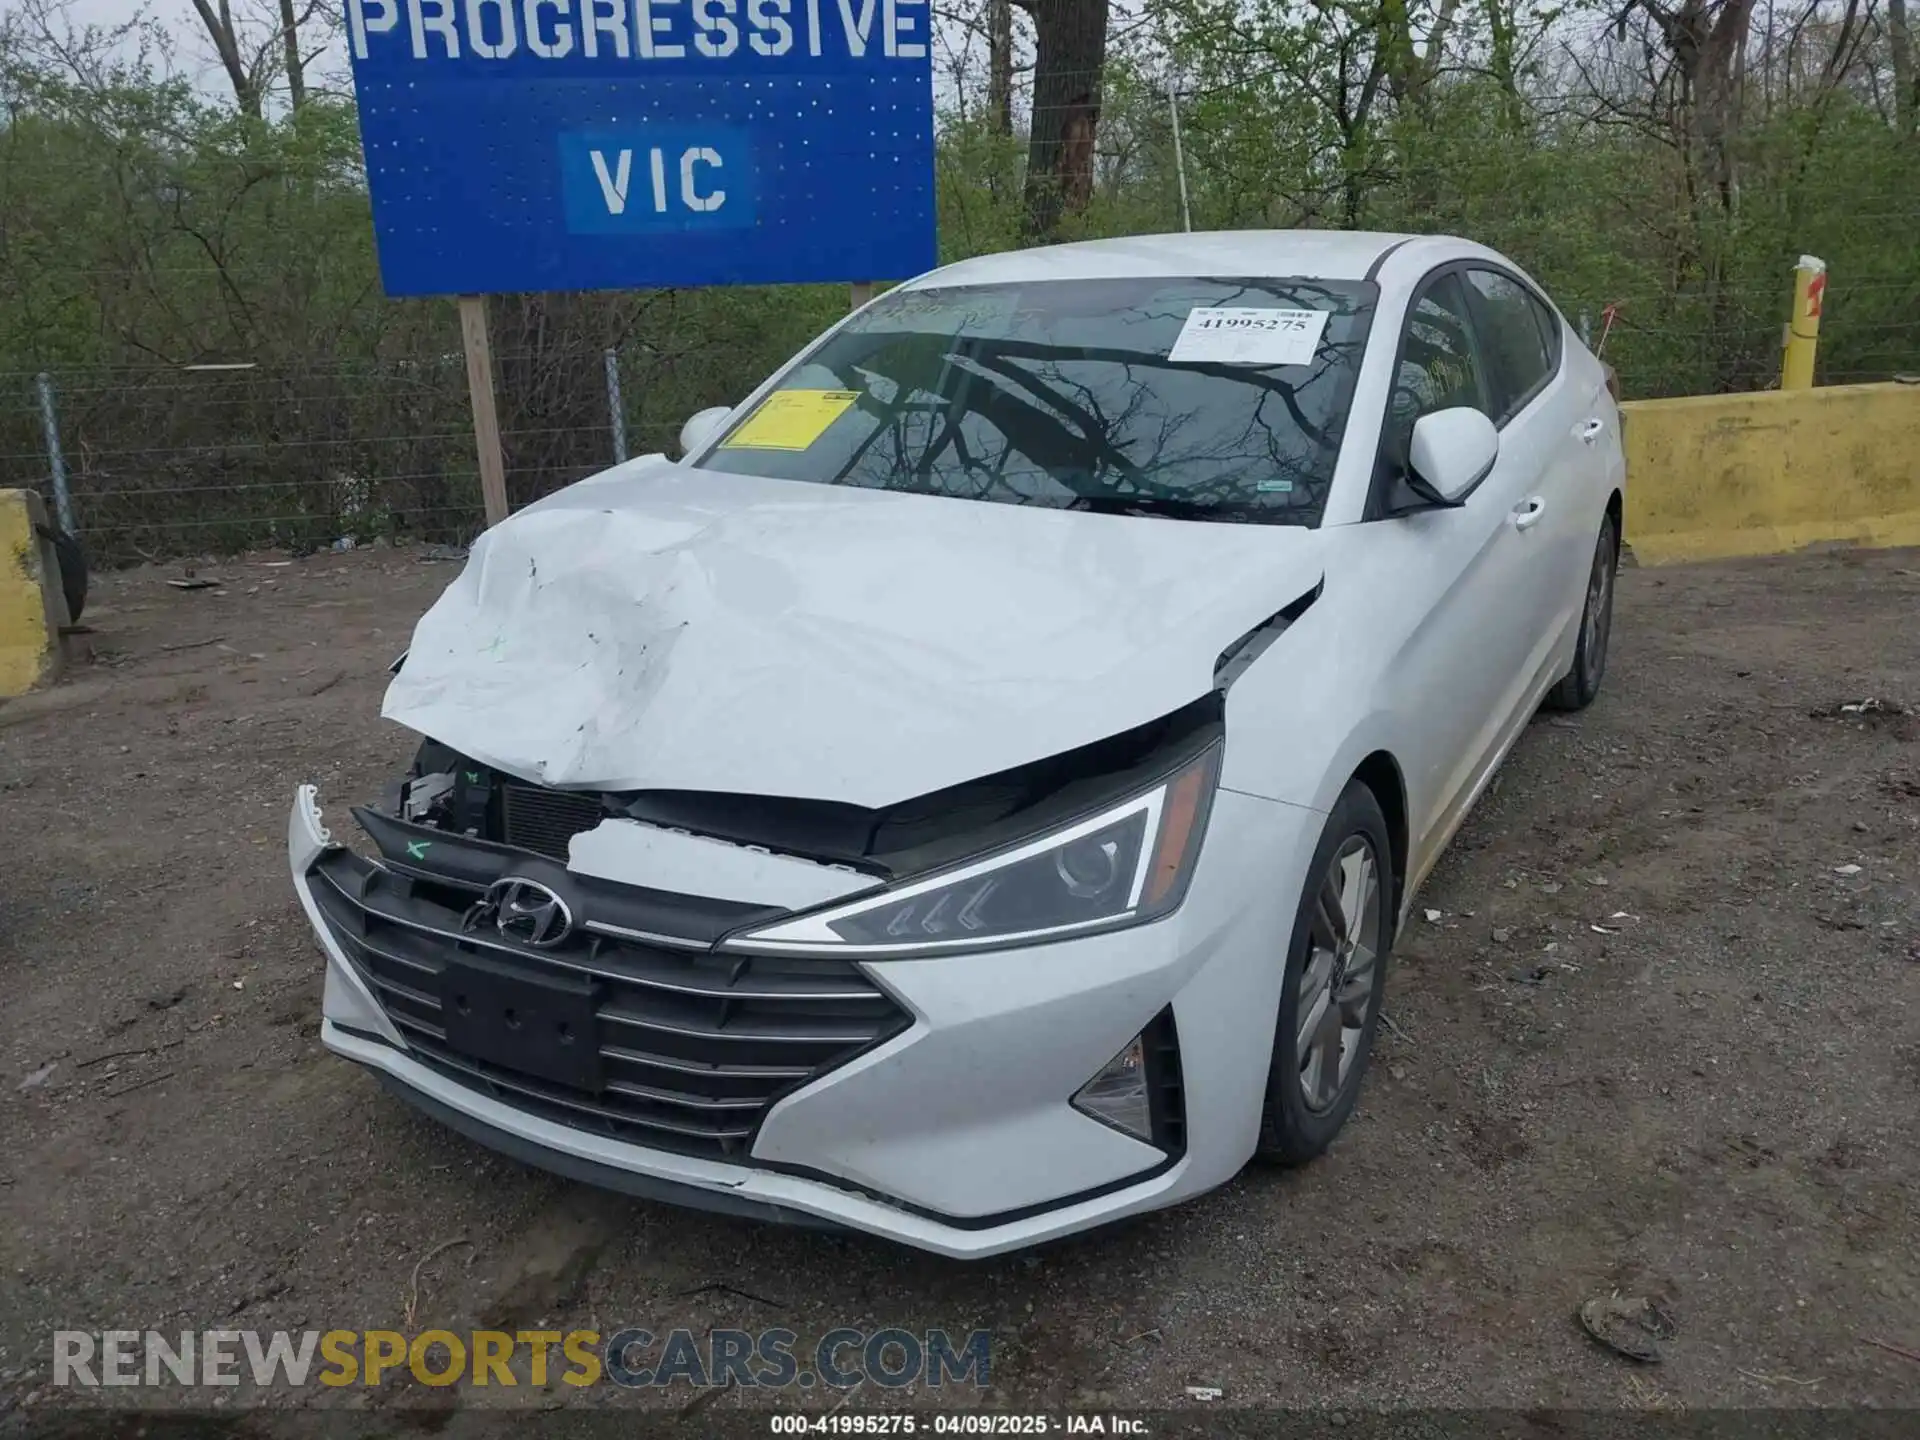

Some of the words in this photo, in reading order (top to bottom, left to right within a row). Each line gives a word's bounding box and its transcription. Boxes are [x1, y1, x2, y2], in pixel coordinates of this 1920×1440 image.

[348, 0, 927, 59] PROGRESSIVE
[590, 147, 726, 214] VIC
[1198, 318, 1307, 331] 41995275
